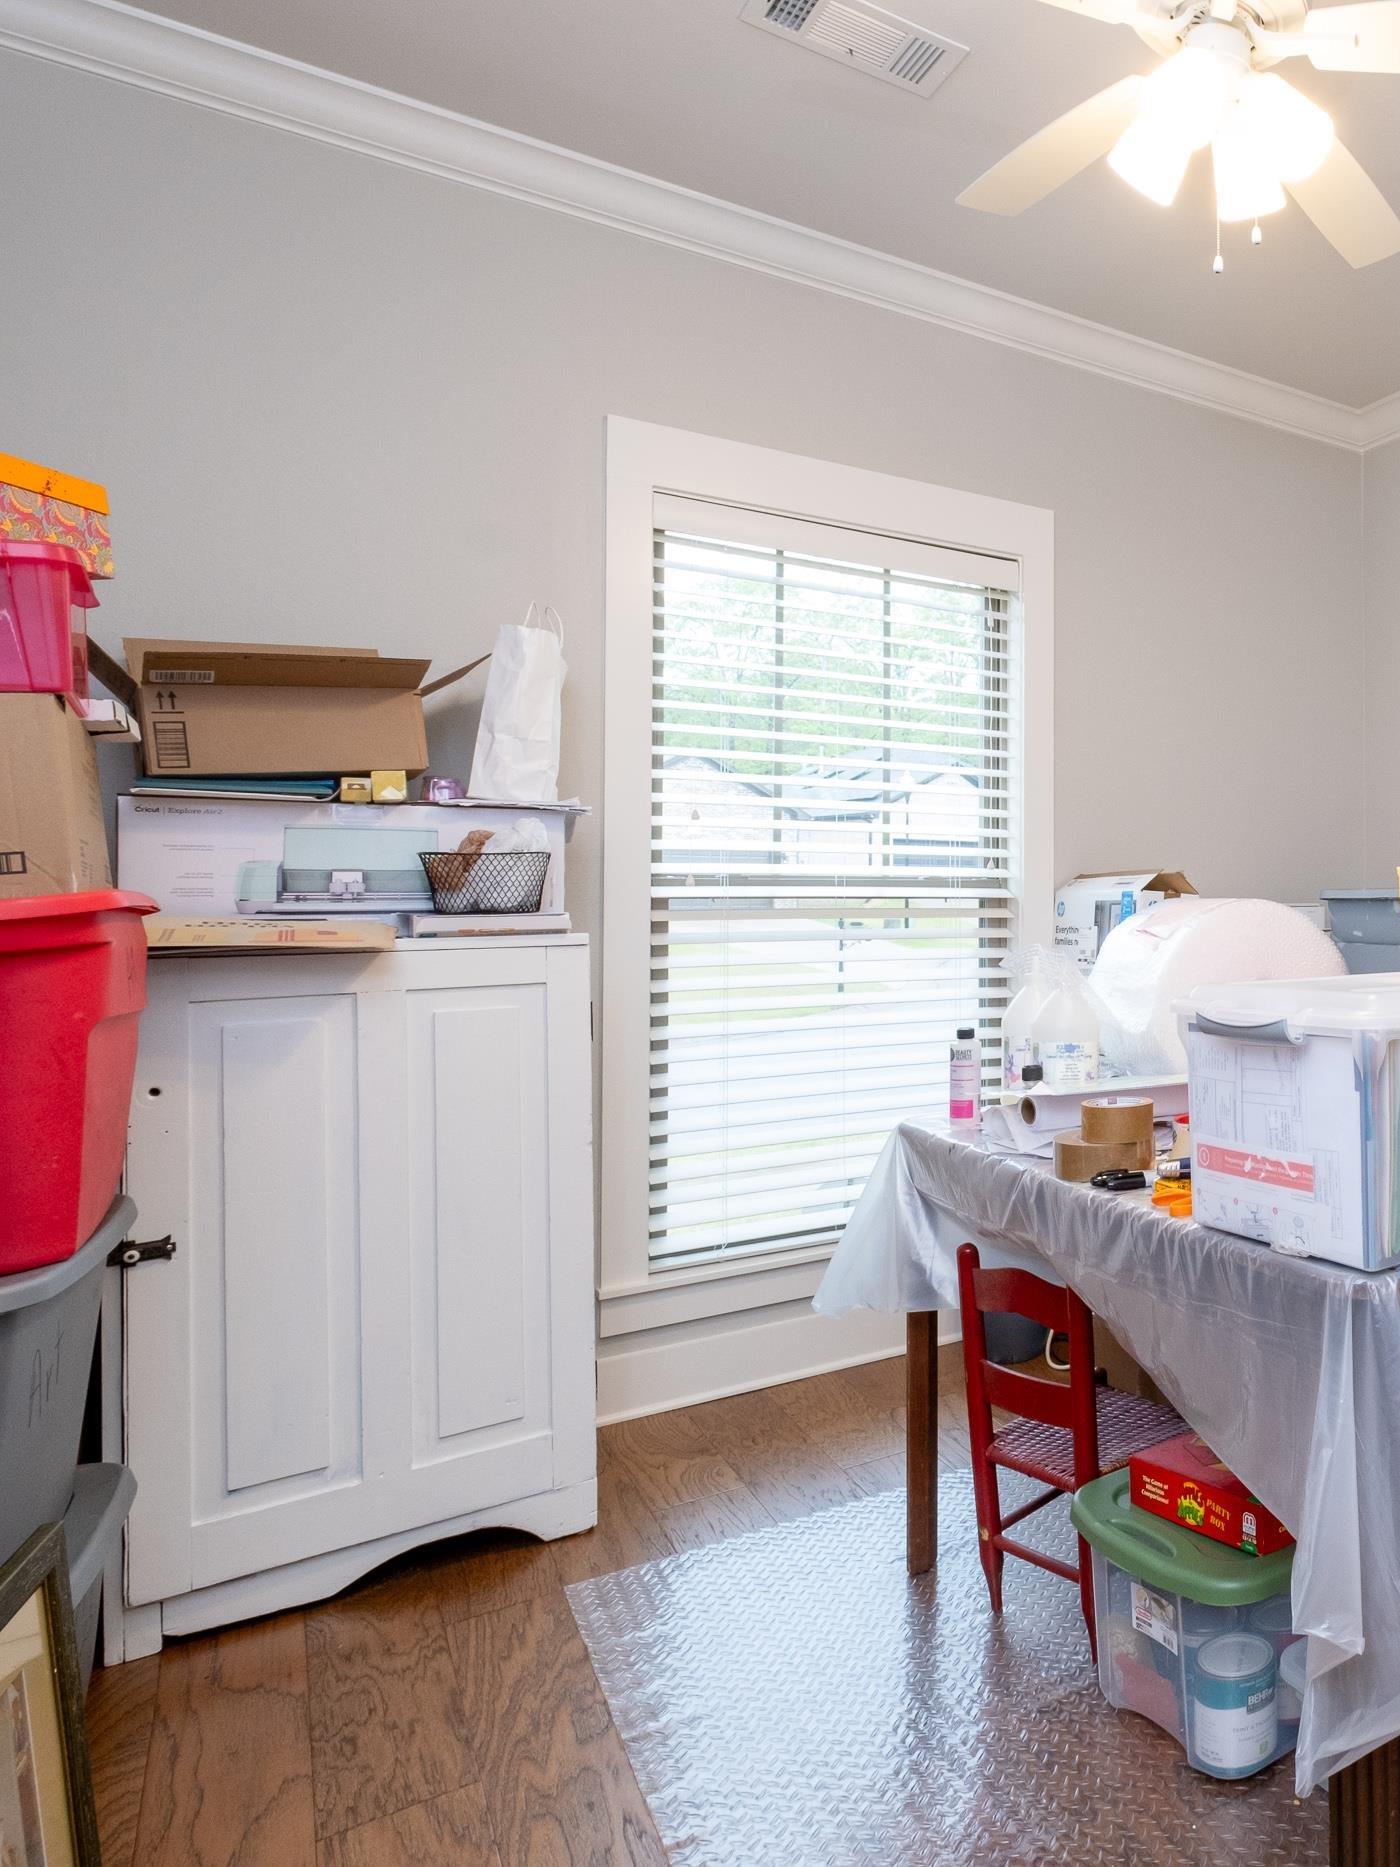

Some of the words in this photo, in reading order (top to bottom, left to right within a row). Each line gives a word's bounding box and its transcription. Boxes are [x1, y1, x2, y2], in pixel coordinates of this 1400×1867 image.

[1055, 925, 1079, 935] Everythin
[1206, 1498, 1232, 1521] PARTY
[1209, 1515, 1226, 1532] BOX
[1248, 1687, 1274, 1706] BEHR
